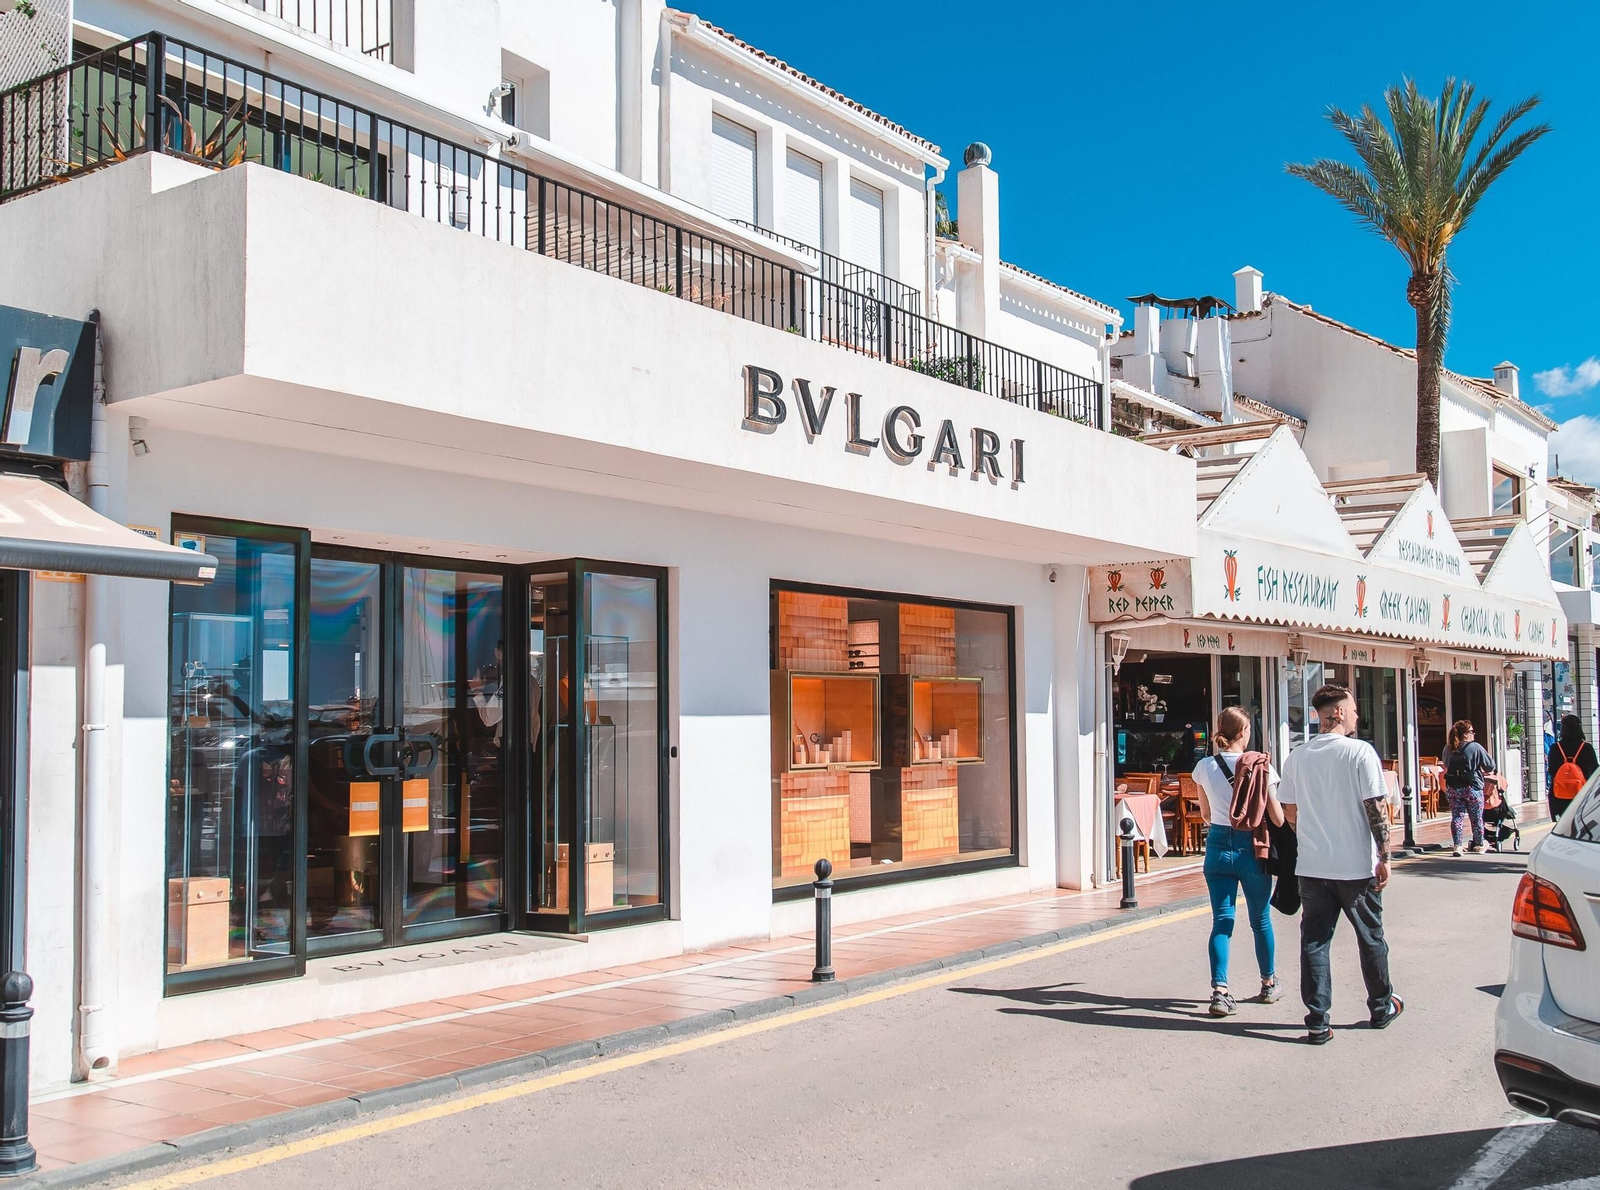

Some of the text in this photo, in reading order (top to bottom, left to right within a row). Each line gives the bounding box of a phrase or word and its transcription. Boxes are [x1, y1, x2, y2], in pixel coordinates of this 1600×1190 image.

[740, 364, 1026, 491] BVLGARI
[1108, 594, 1174, 613] RED PEPPER
[1257, 565, 1340, 613] FISH RESTAURANT
[1379, 589, 1431, 629] GREEK TAVERN
[1460, 606, 1507, 640] CHARCOAL GRILL
[332, 940, 519, 973] BVLGARI
